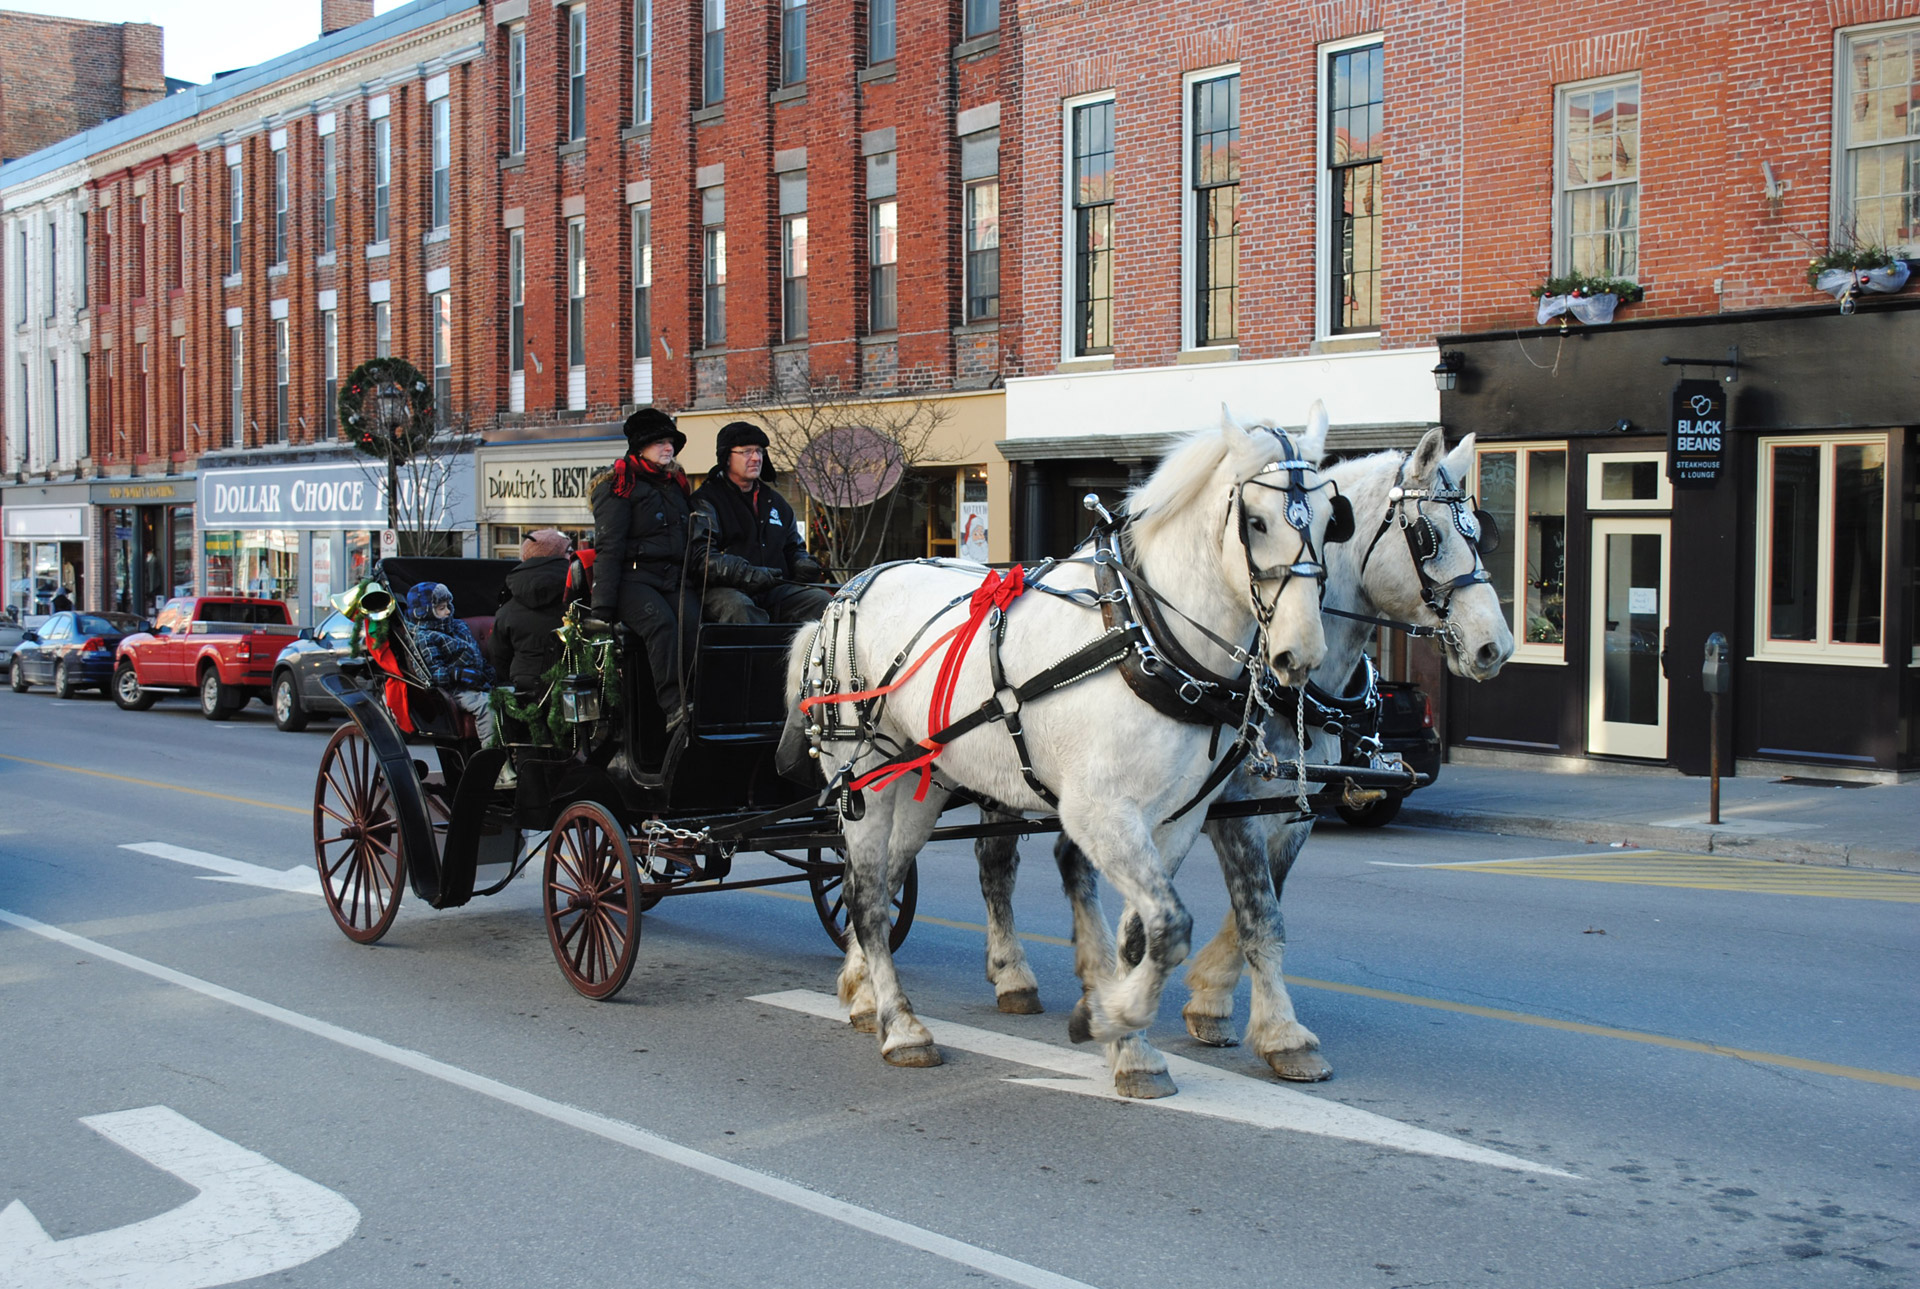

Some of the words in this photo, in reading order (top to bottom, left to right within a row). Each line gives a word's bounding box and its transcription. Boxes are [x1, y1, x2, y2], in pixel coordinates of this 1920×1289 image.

[1677, 420, 1721, 435] BLACK
[1677, 437, 1721, 451] BEANS
[1676, 461, 1720, 469] STEAKHOUSE
[1687, 471, 1715, 479] LOUNGE
[488, 469, 547, 499] Dimitri's
[552, 466, 596, 498] REST
[214, 483, 281, 513] DOLLAR
[291, 479, 364, 512] CHOICE
[375, 476, 430, 510] PUS
